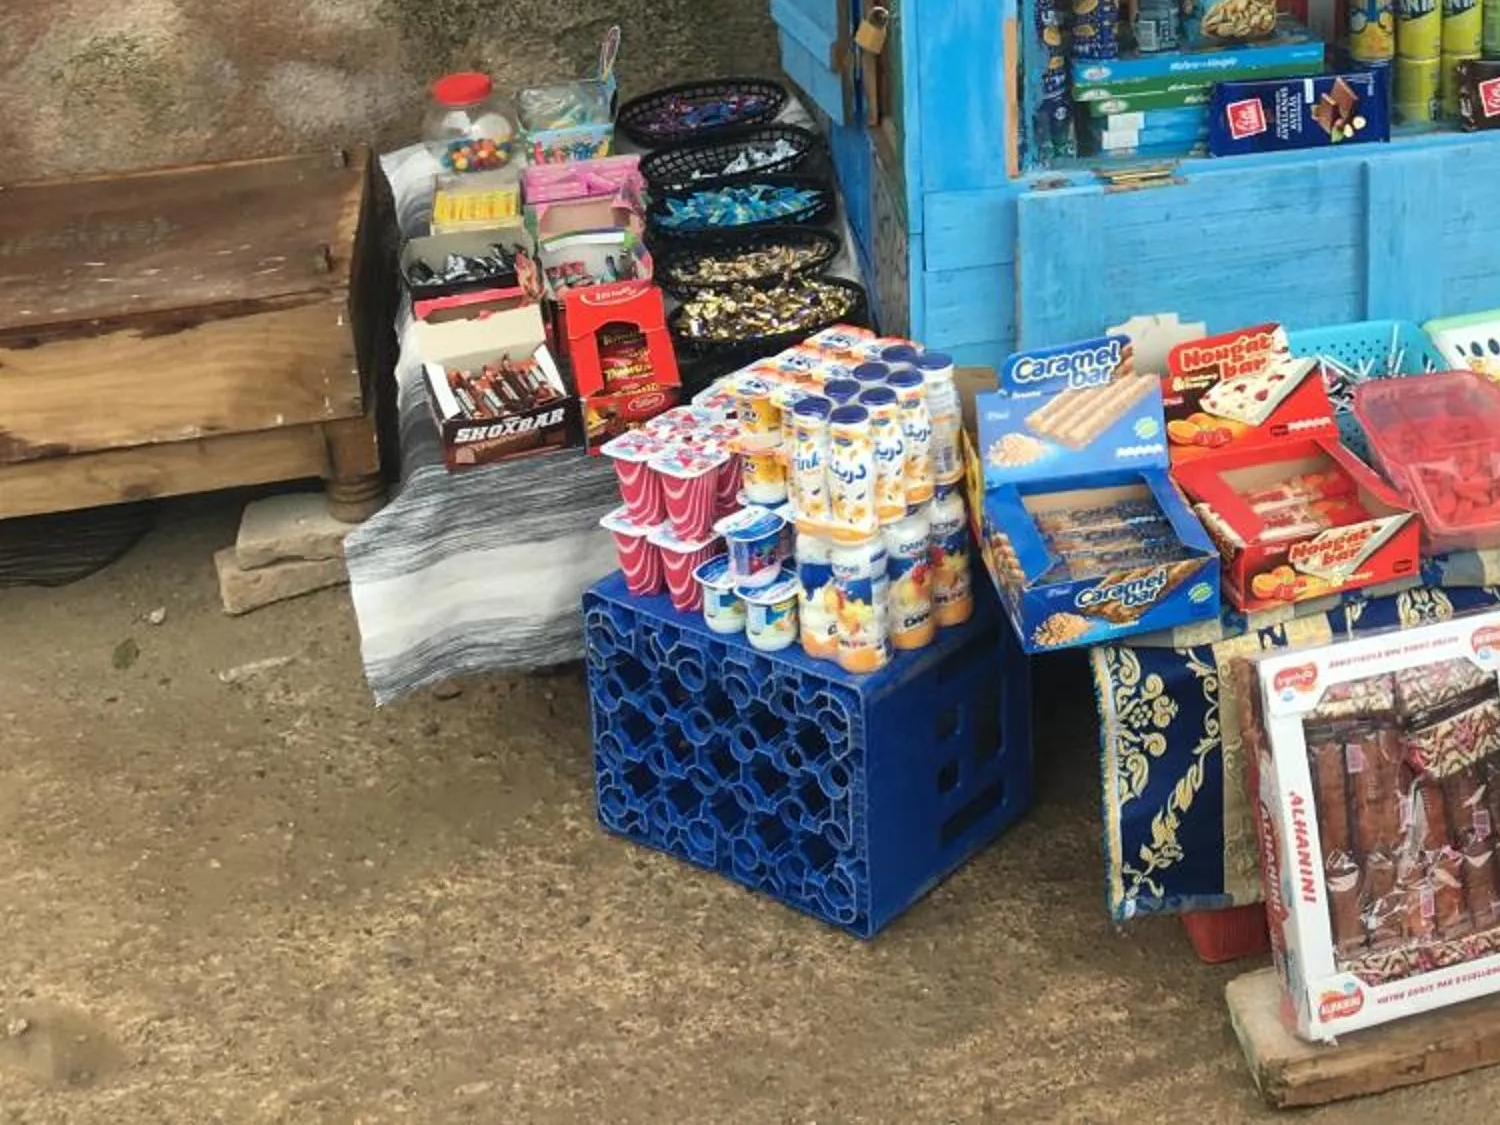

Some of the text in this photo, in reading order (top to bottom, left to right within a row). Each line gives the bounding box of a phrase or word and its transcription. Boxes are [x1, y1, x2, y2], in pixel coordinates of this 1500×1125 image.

[1012, 341, 1120, 384] Caramel
[1180, 334, 1273, 371] Nougat
[1220, 357, 1268, 379] bar
[1069, 365, 1112, 389] bar
[454, 409, 566, 444] SHOXBAR
[1075, 569, 1168, 608] Caramel
[1289, 792, 1318, 904] ALHANINI
